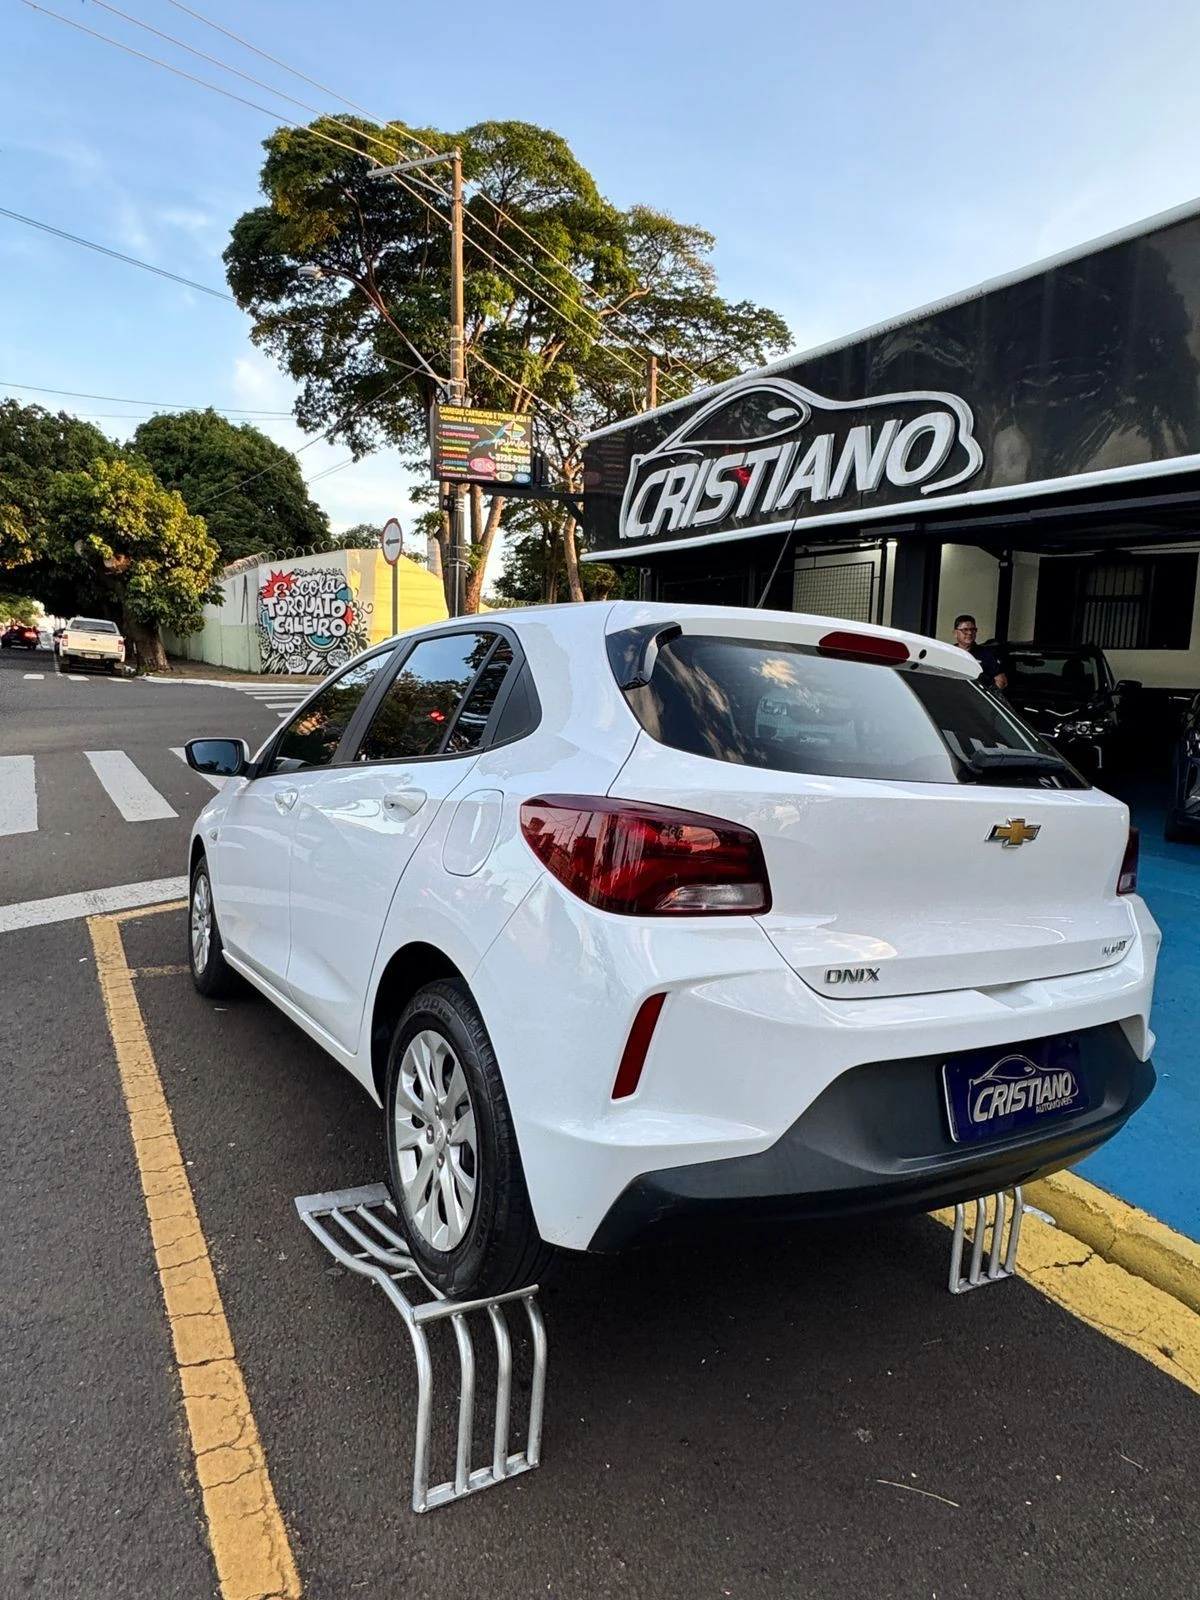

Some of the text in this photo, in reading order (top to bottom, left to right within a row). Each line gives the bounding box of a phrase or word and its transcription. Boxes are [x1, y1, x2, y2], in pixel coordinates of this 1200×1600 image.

[624, 412, 956, 538] CRISTIANO
[273, 573, 346, 597] Escola
[262, 594, 347, 618] TORQUATO
[273, 616, 348, 637] CALEIRO
[824, 967, 881, 985] ONIX
[972, 1071, 1073, 1123] CRISTIANO
